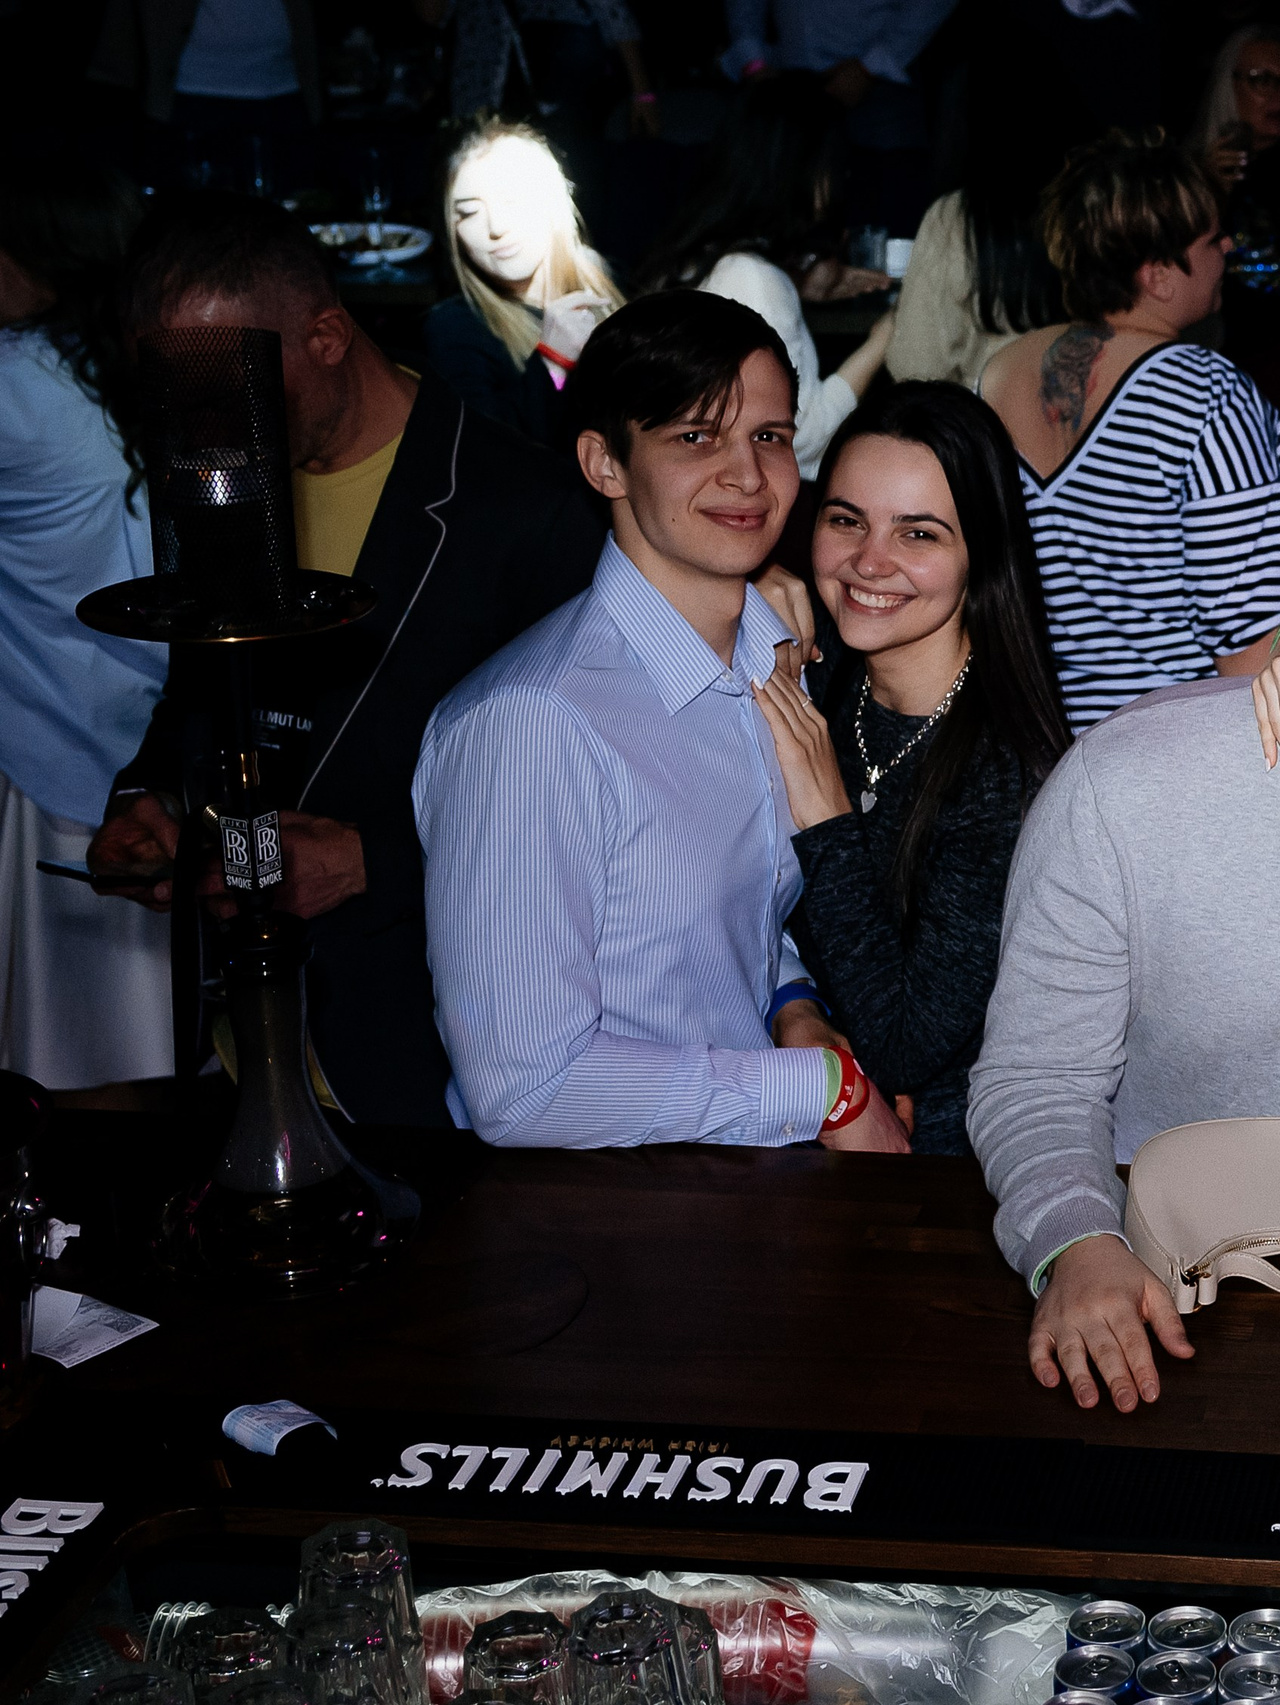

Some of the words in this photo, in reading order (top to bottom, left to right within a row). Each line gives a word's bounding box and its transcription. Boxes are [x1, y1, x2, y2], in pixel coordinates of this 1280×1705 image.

[251, 708, 295, 728] ELMUT
[221, 818, 246, 829] RUKI
[254, 813, 277, 828] RUKI
[225, 874, 253, 891] SMOKE
[257, 869, 284, 889] SMOKE
[384, 1442, 871, 1514] BUSHMILLS
